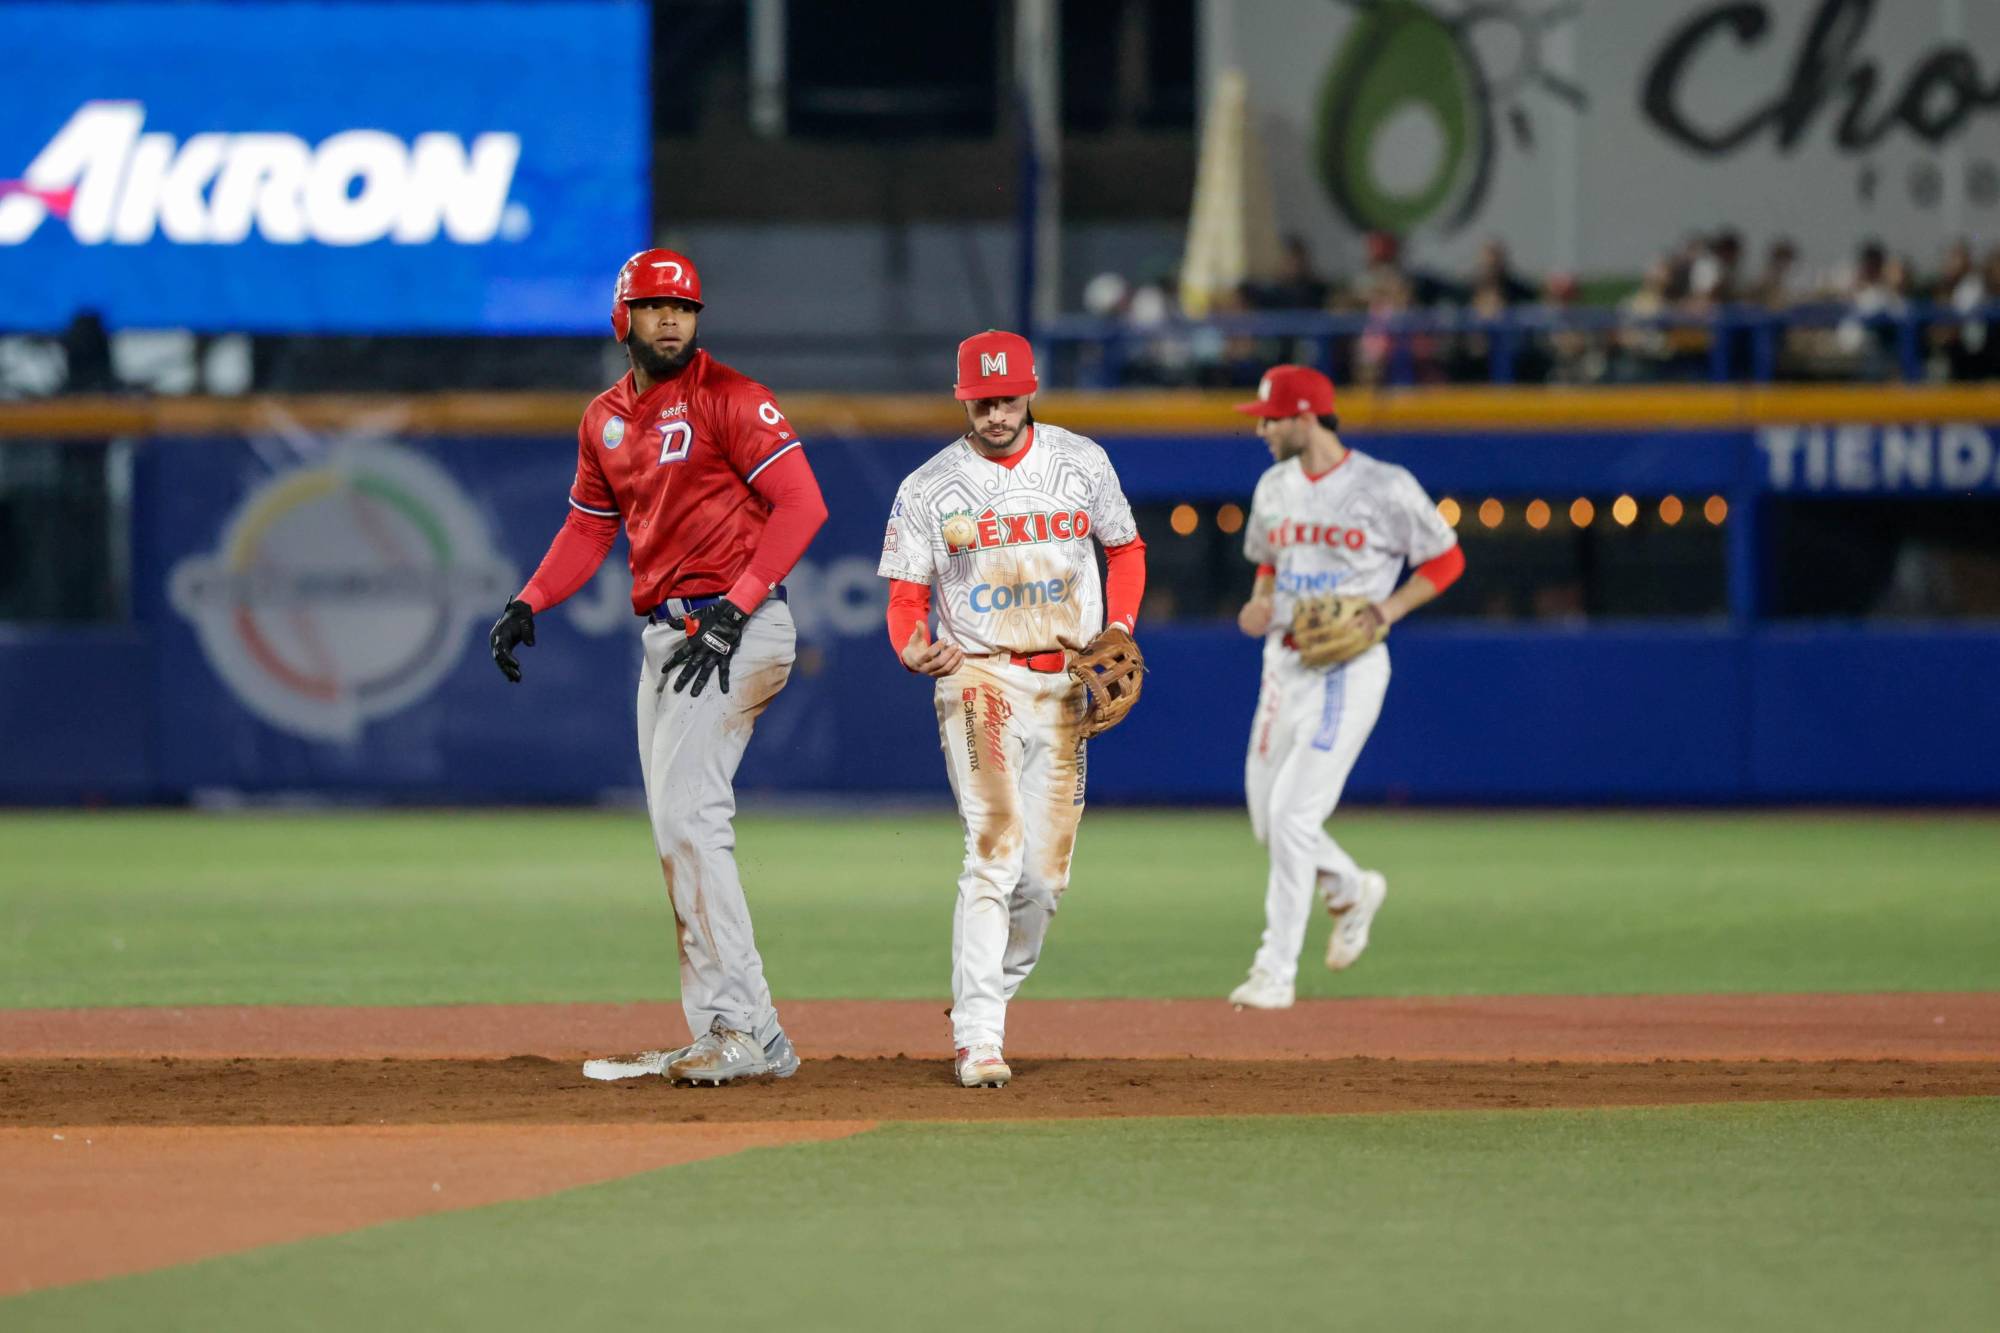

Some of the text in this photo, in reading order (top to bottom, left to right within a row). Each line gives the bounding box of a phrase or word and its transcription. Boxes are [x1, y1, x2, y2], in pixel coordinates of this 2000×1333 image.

[0, 100, 521, 246] AKRON
[980, 351, 1008, 377] M
[657, 420, 693, 466] D
[1757, 424, 2000, 490] TIEND
[941, 504, 1092, 556] ÉXICO
[964, 700, 980, 772] caliente.mx
